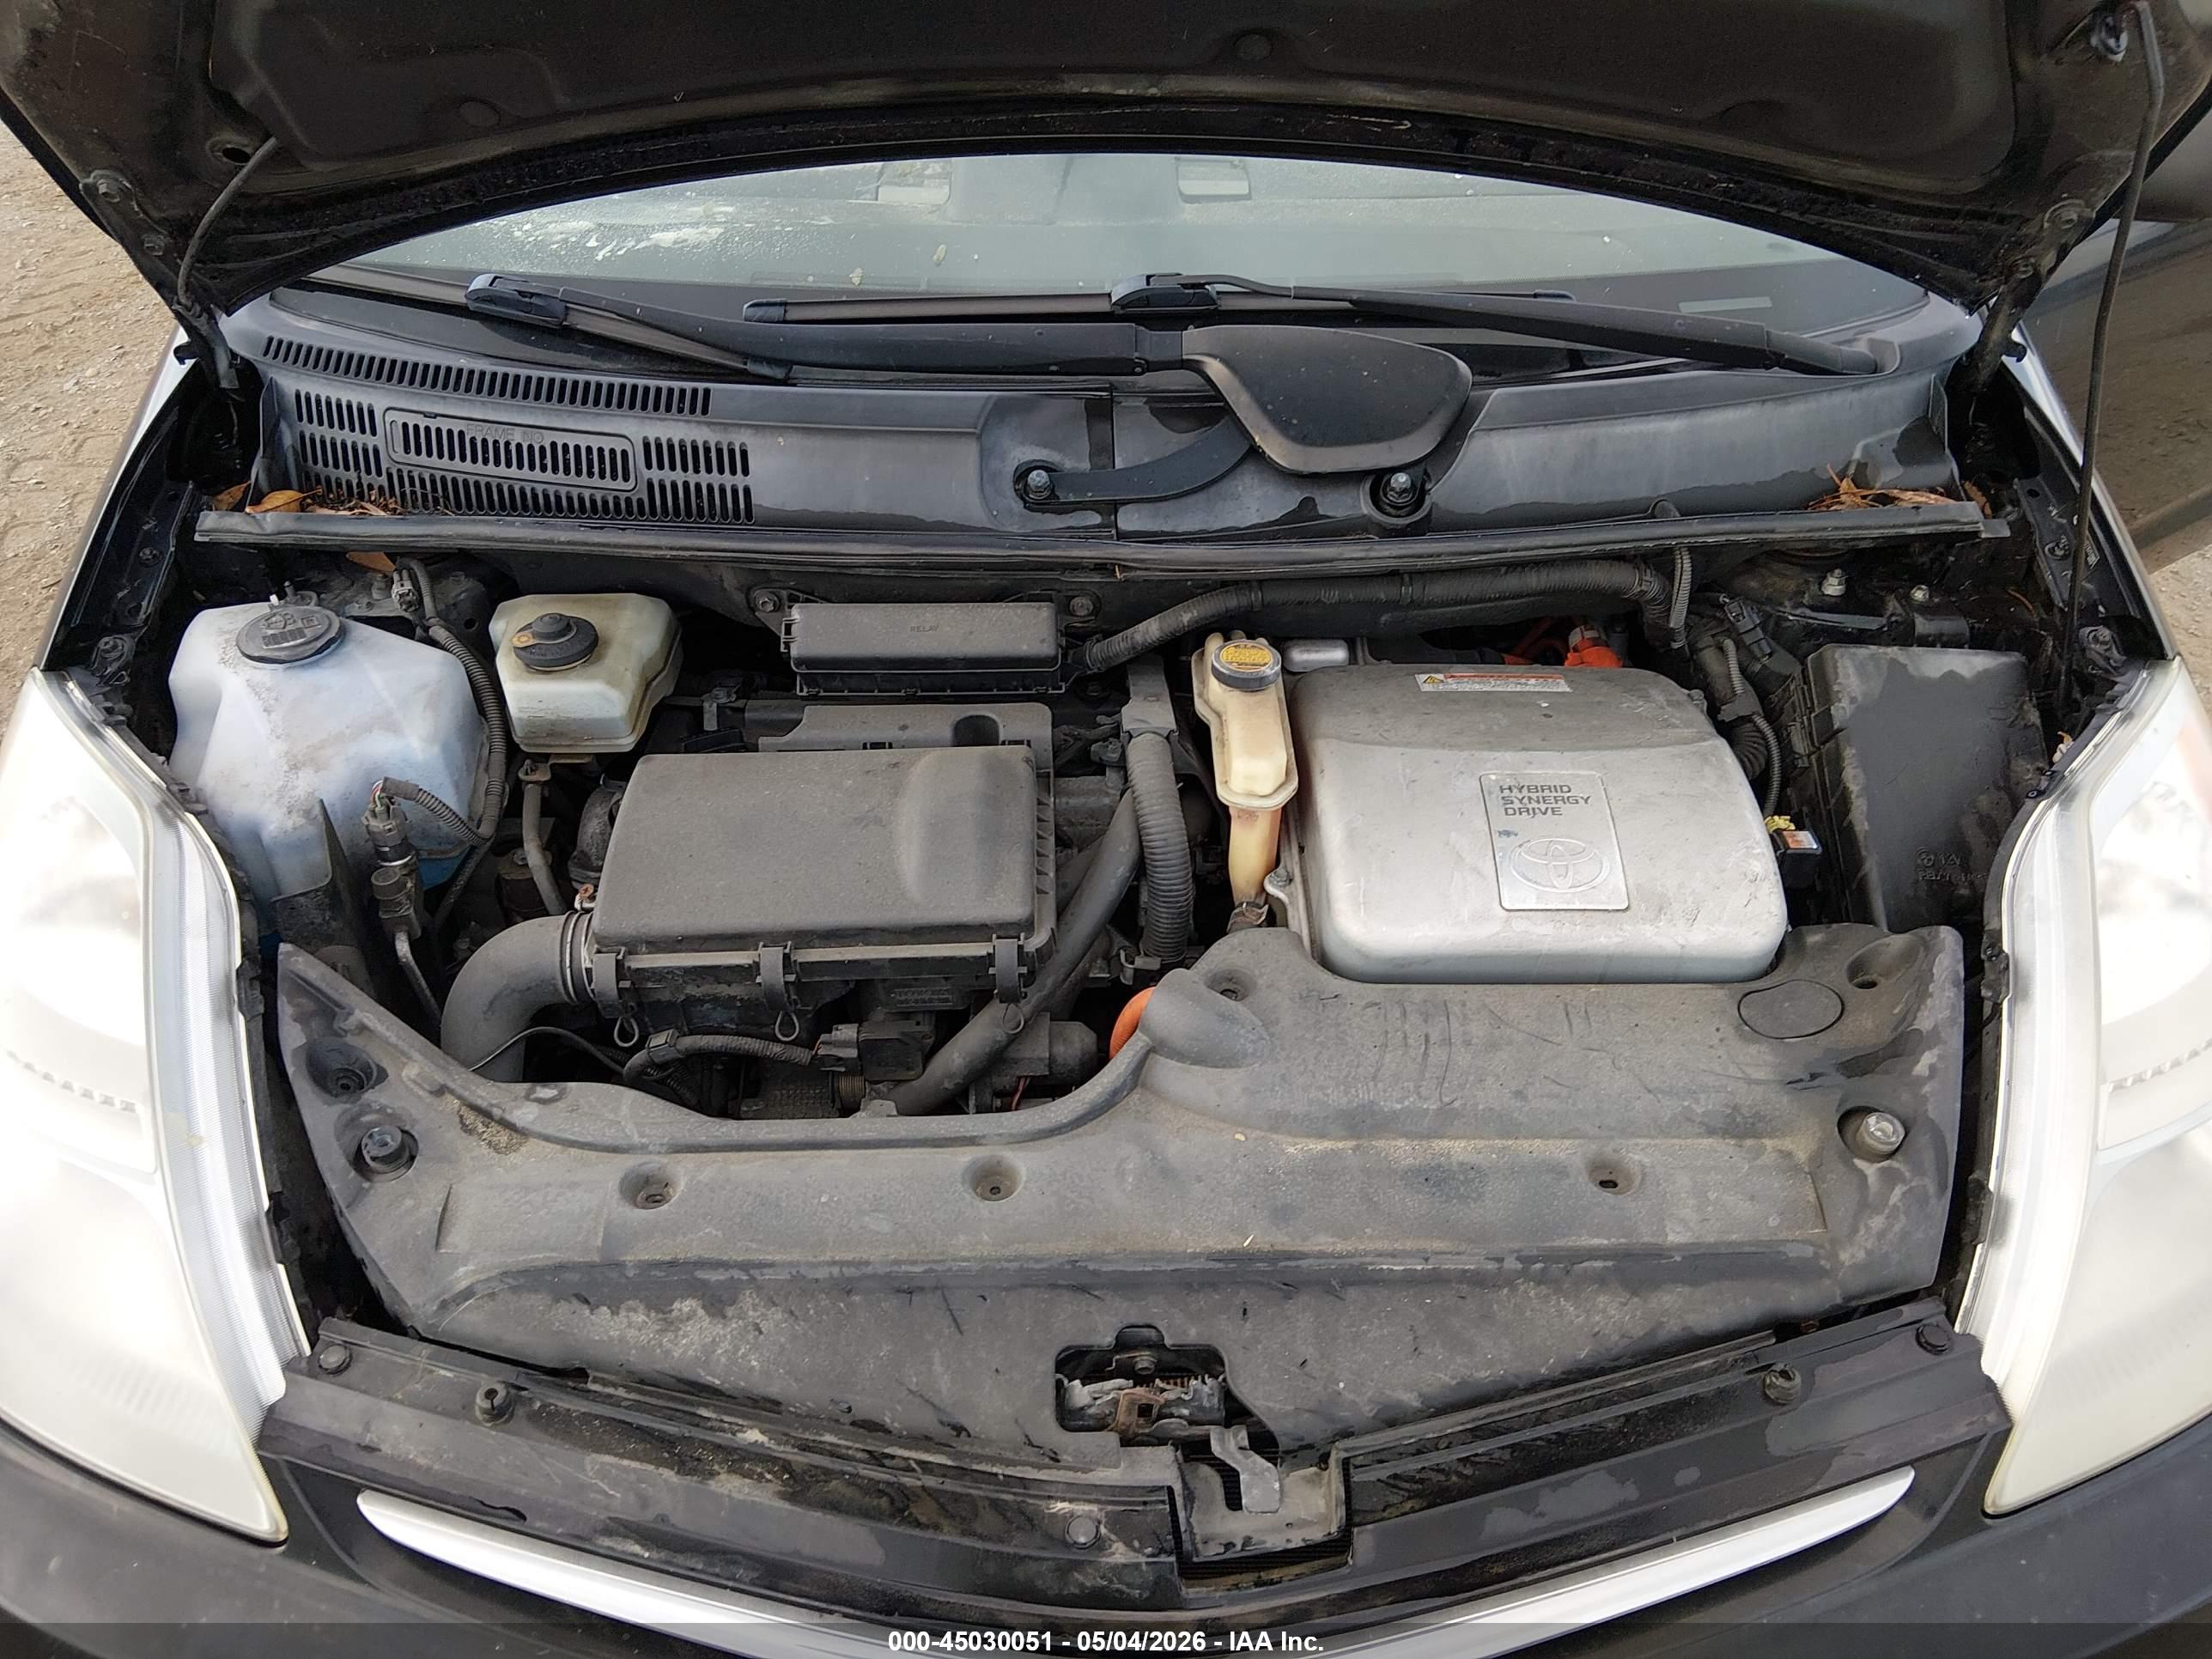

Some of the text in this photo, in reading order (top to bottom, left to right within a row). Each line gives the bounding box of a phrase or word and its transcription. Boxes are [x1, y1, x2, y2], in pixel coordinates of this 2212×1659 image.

[466, 423, 515, 441] FRAME
[1499, 784, 1572, 793] HYBRID
[1501, 795, 1591, 805] SYNERGY
[1504, 807, 1563, 817] DRIVE
